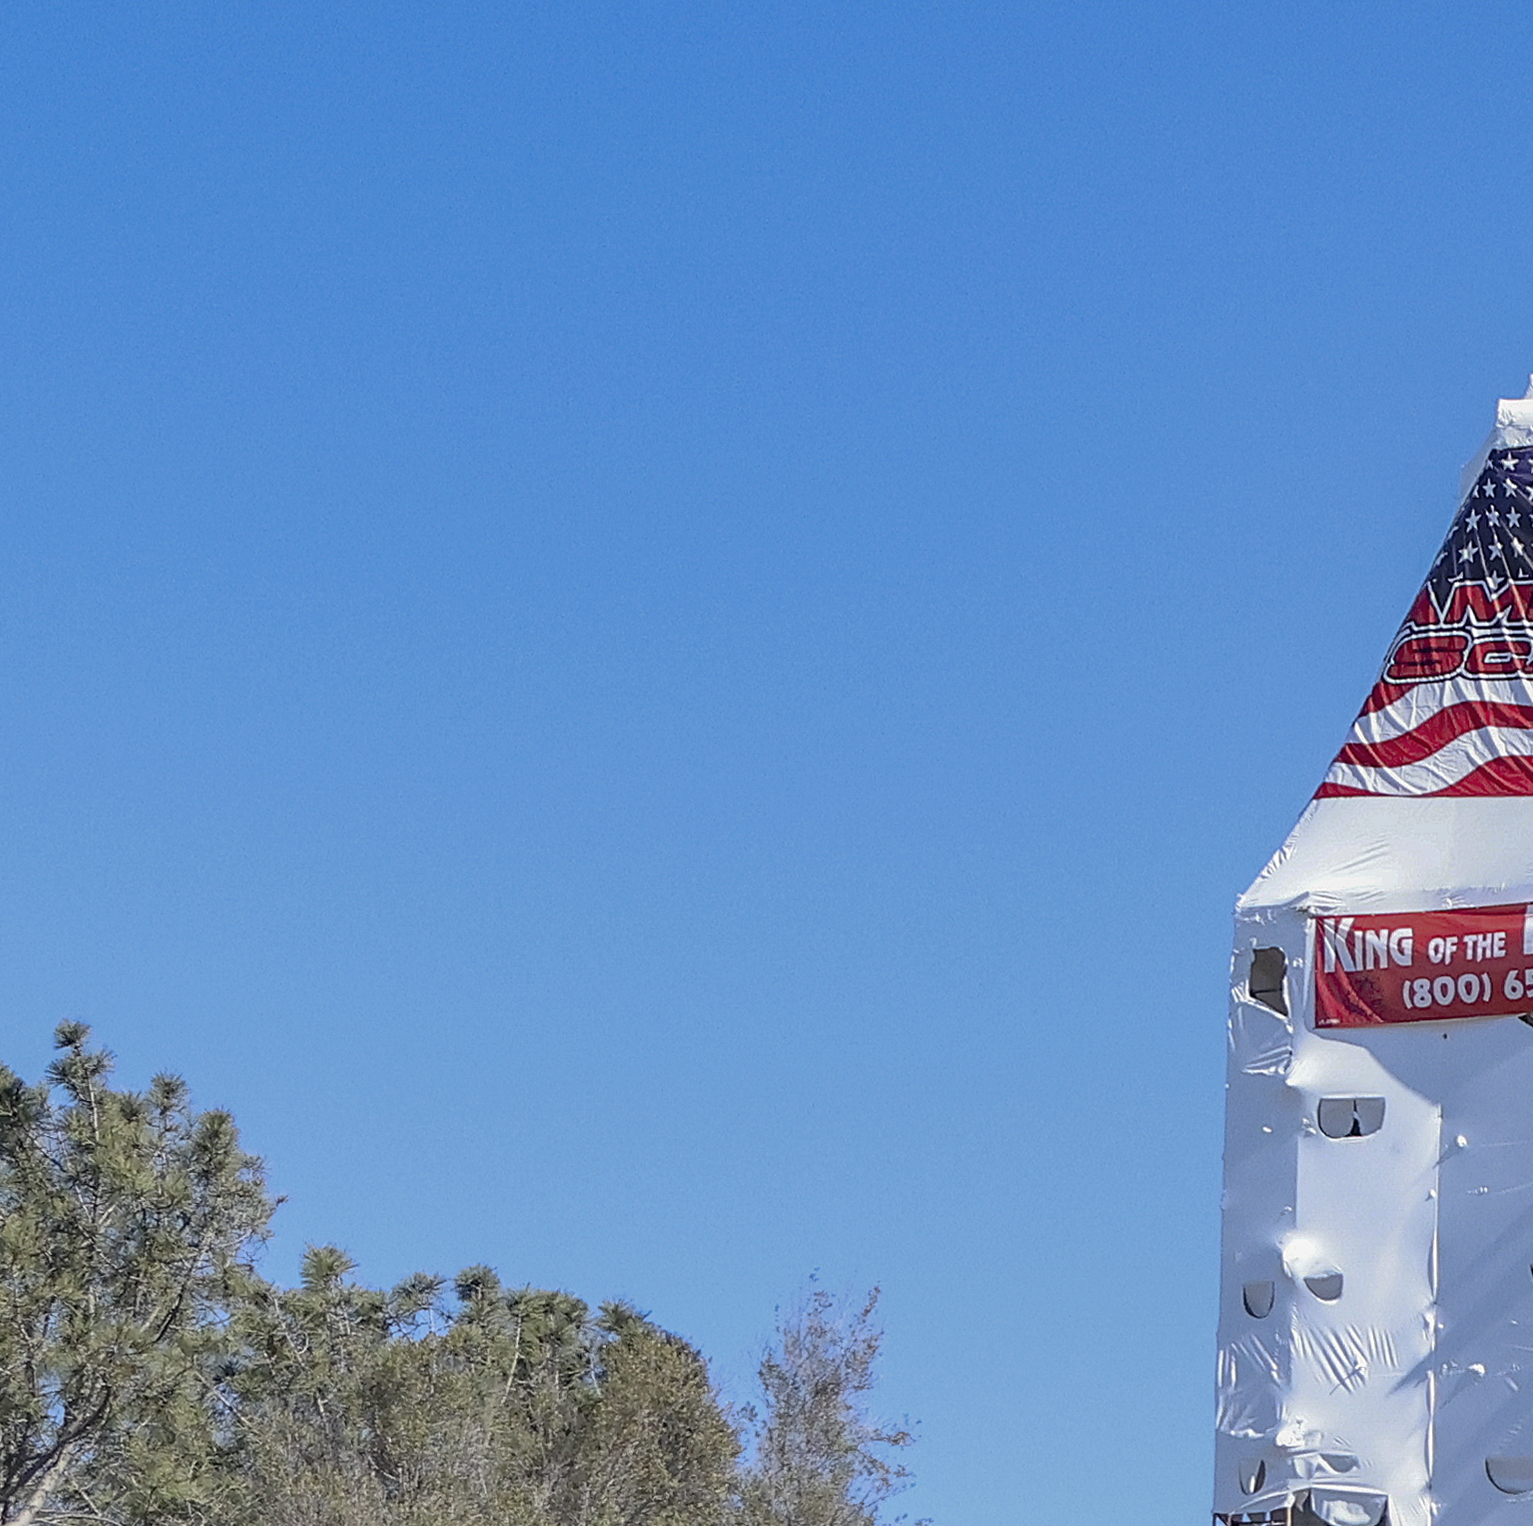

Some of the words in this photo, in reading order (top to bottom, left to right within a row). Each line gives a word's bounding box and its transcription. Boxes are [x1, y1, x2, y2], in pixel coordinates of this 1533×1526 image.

[1324, 916, 1413, 974] KING
[1427, 936, 1458, 965] OF
[1464, 933, 1506, 957] THE
[1402, 974, 1492, 1009] (800)
